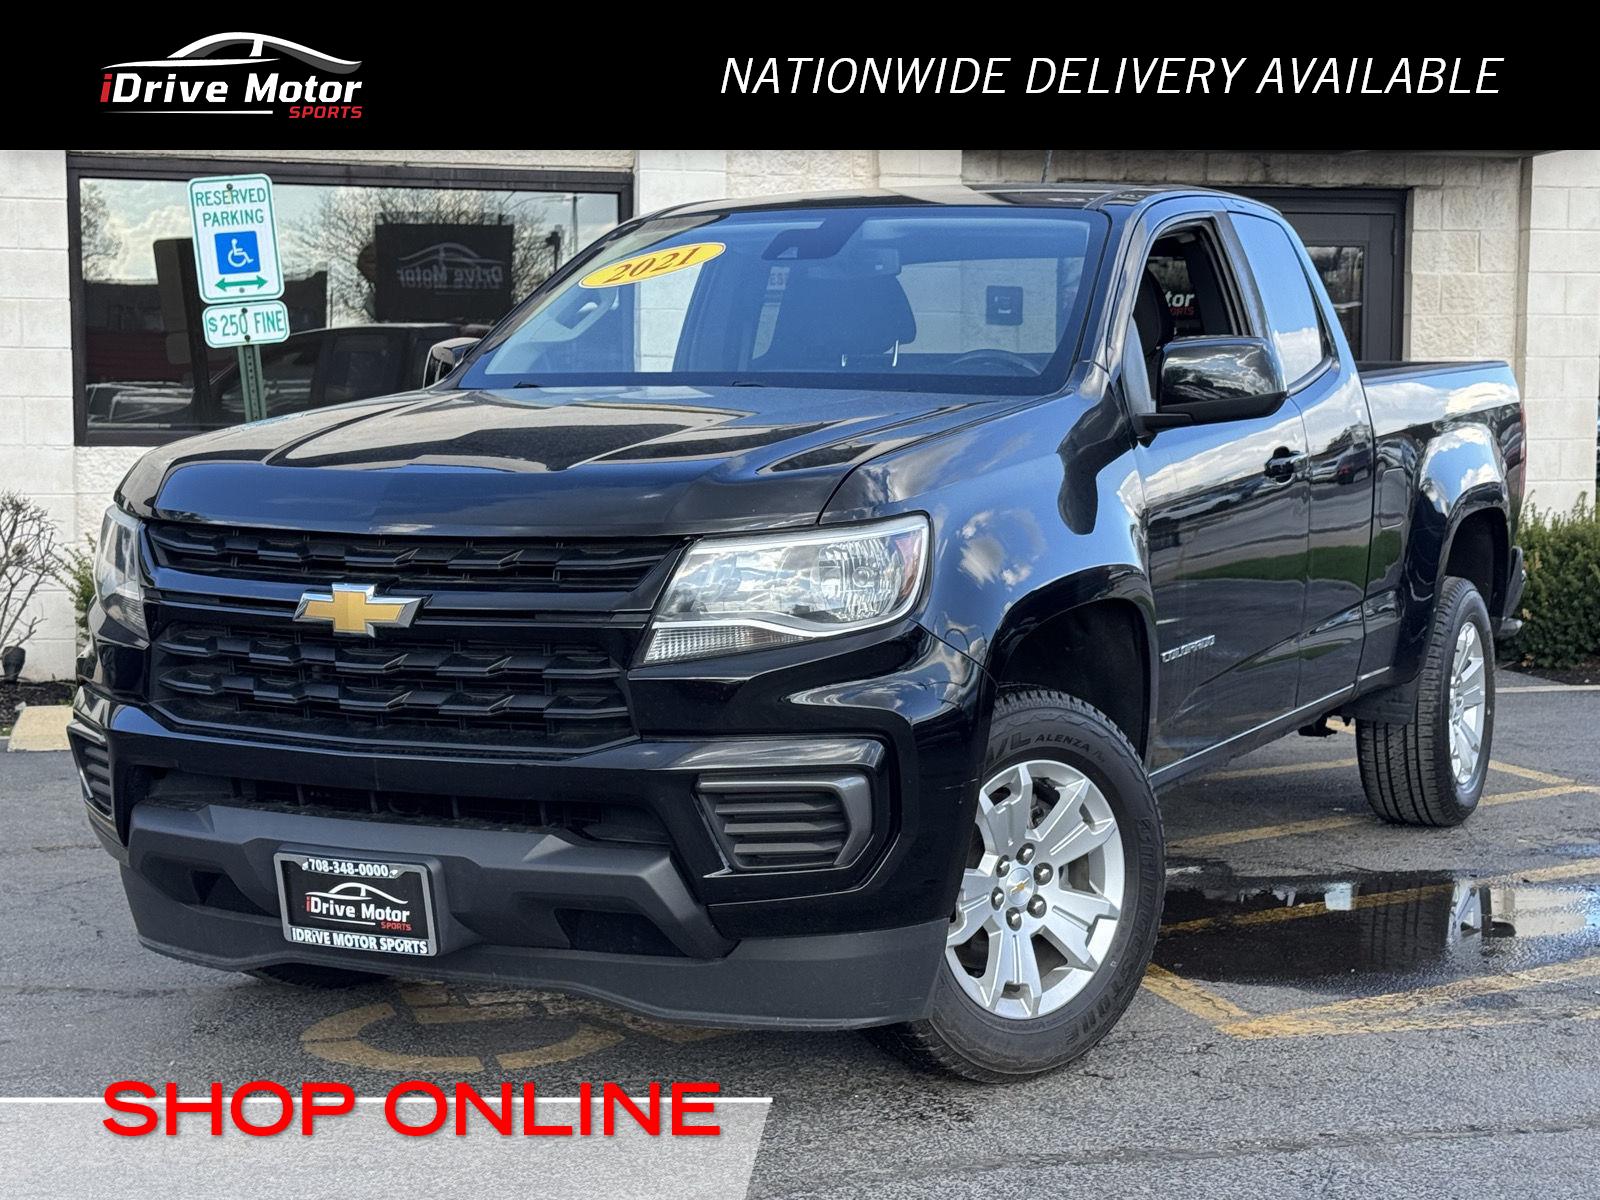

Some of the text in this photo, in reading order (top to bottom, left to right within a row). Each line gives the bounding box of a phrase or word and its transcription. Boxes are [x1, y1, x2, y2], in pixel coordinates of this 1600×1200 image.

[195, 187, 267, 207] RESERVED
[202, 208, 265, 228] PARKING
[602, 246, 702, 284] 2021
[208, 310, 285, 337] $250 FINE
[1033, 733, 1091, 752] ALENZA
[308, 858, 389, 877] 708-348-0000
[305, 895, 411, 923] iDrive Motor
[380, 921, 412, 931] SPORTS
[332, 932, 378, 950] MOTOR
[379, 938, 428, 954] SPORTS
